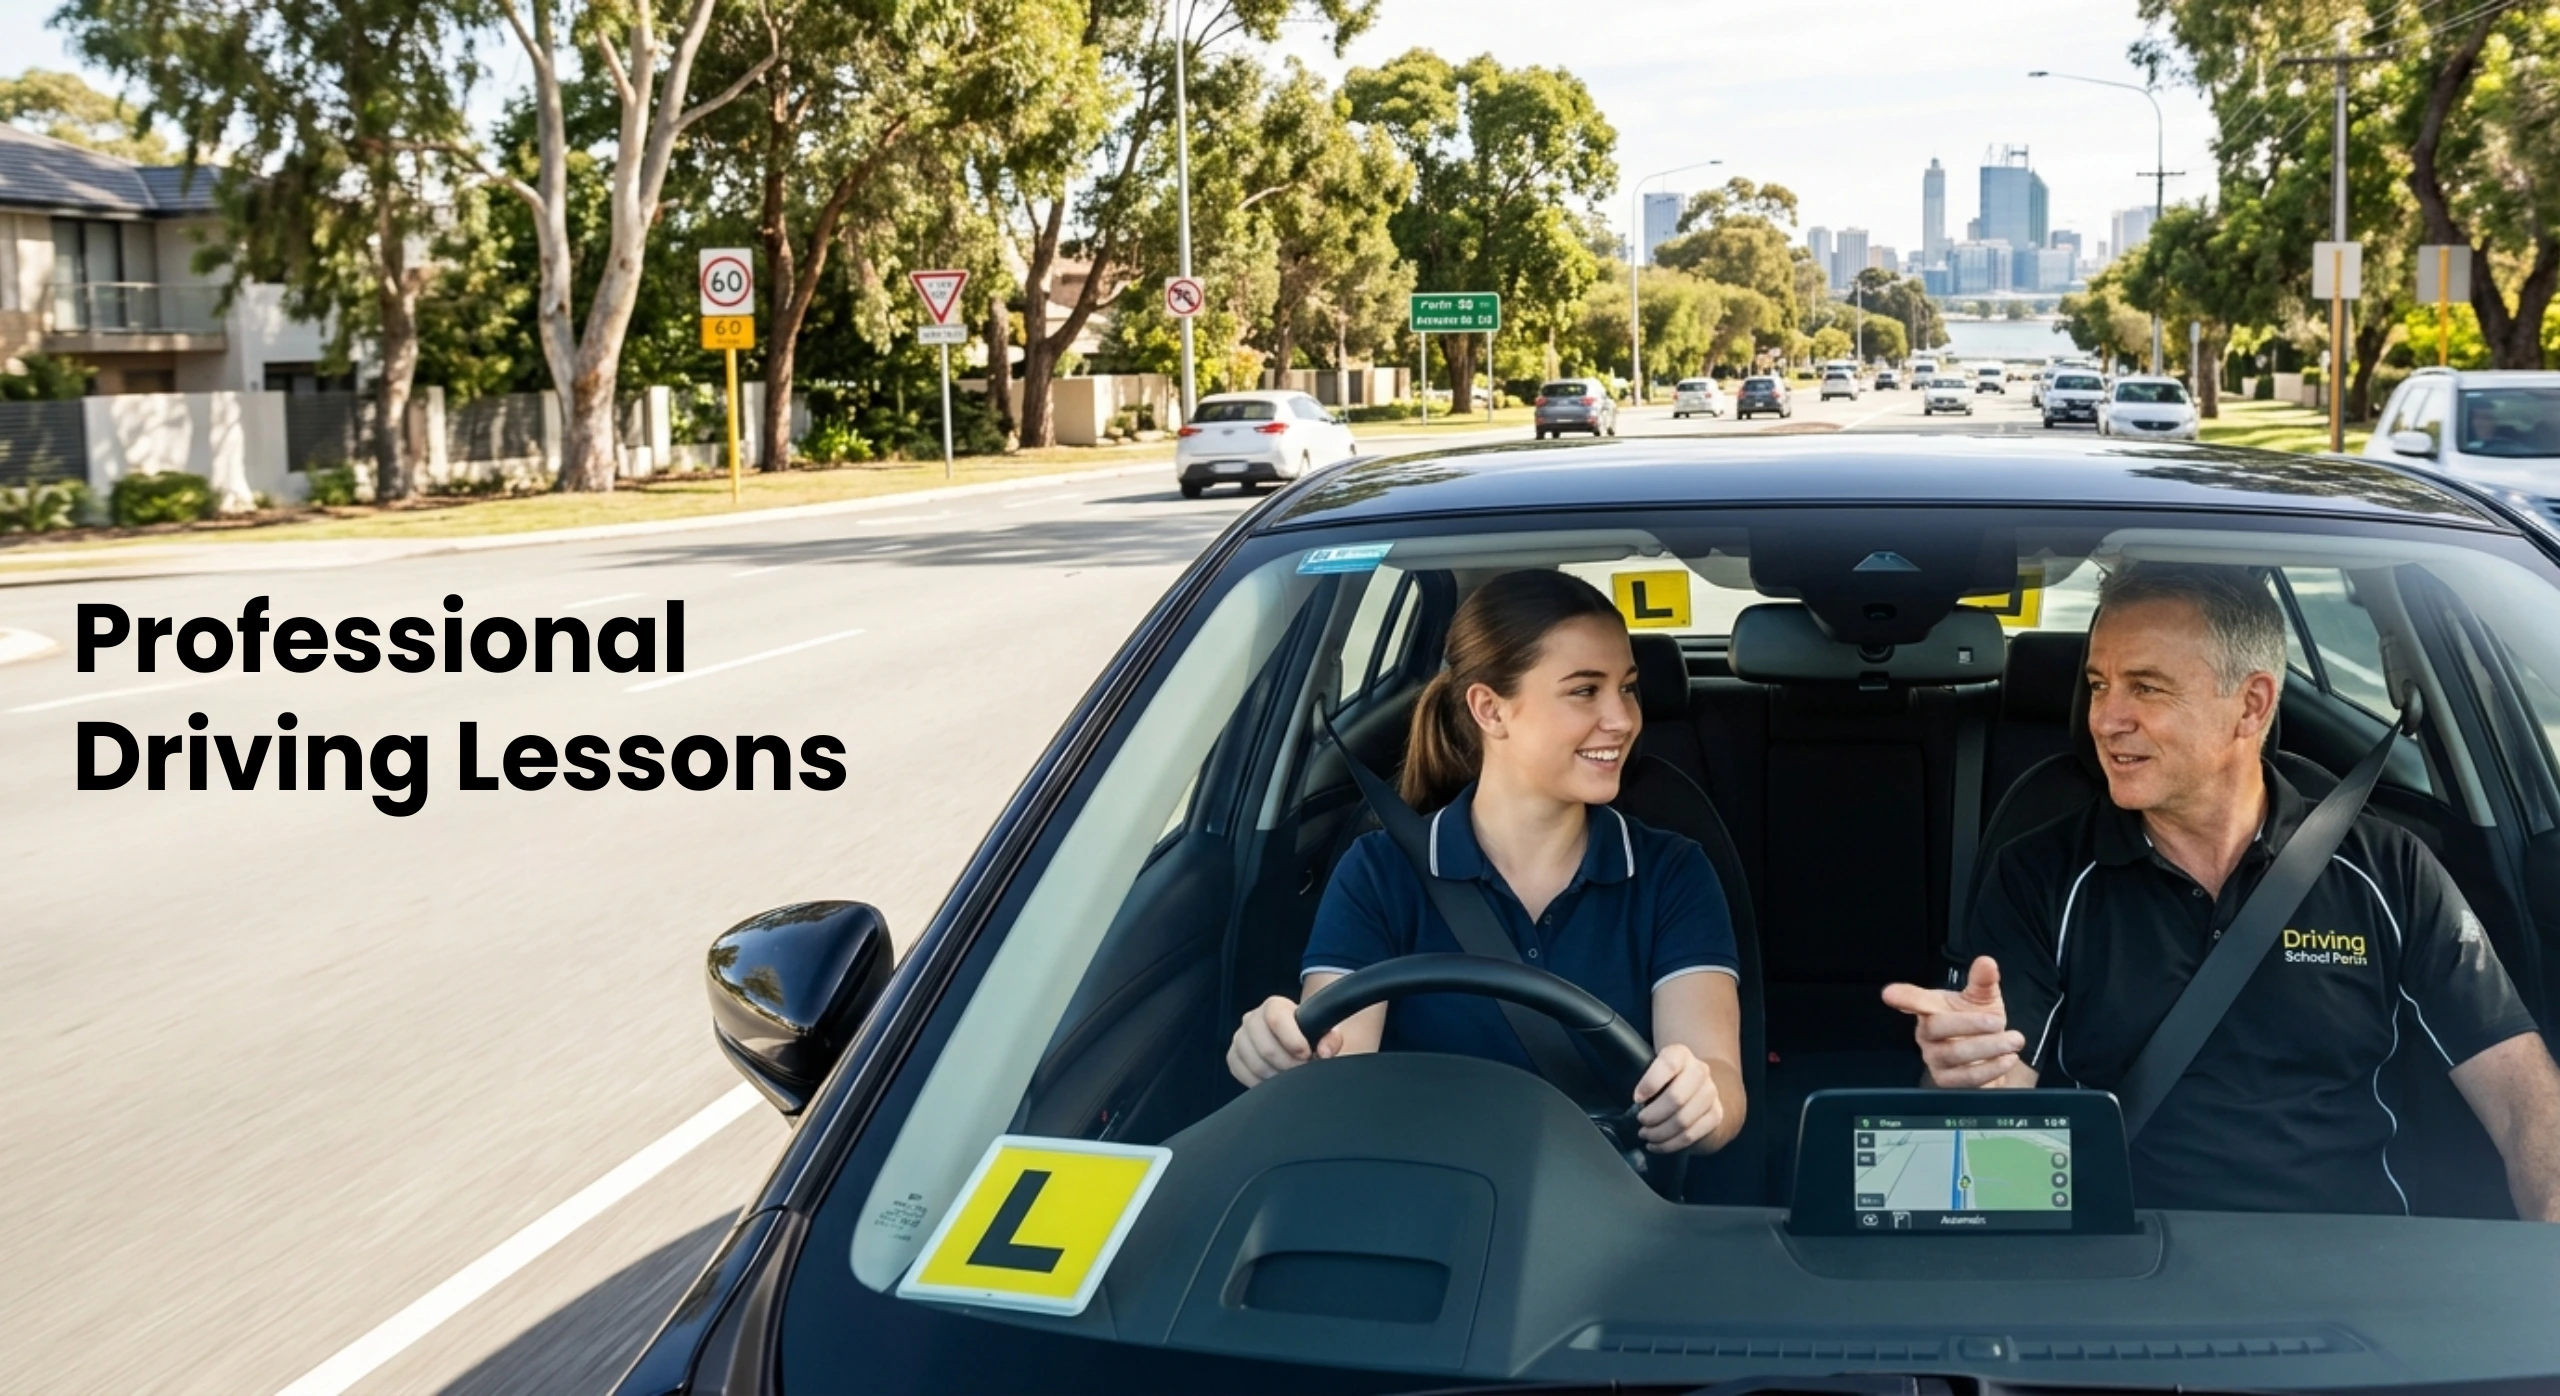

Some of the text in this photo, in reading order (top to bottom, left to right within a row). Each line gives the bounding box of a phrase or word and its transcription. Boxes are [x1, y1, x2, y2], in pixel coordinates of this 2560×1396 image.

[711, 270, 743, 293] 60
[715, 319, 742, 336] 60
[1631, 580, 1673, 619] L
[2283, 929, 2366, 956] Driving
[965, 1168, 1066, 1275] L
